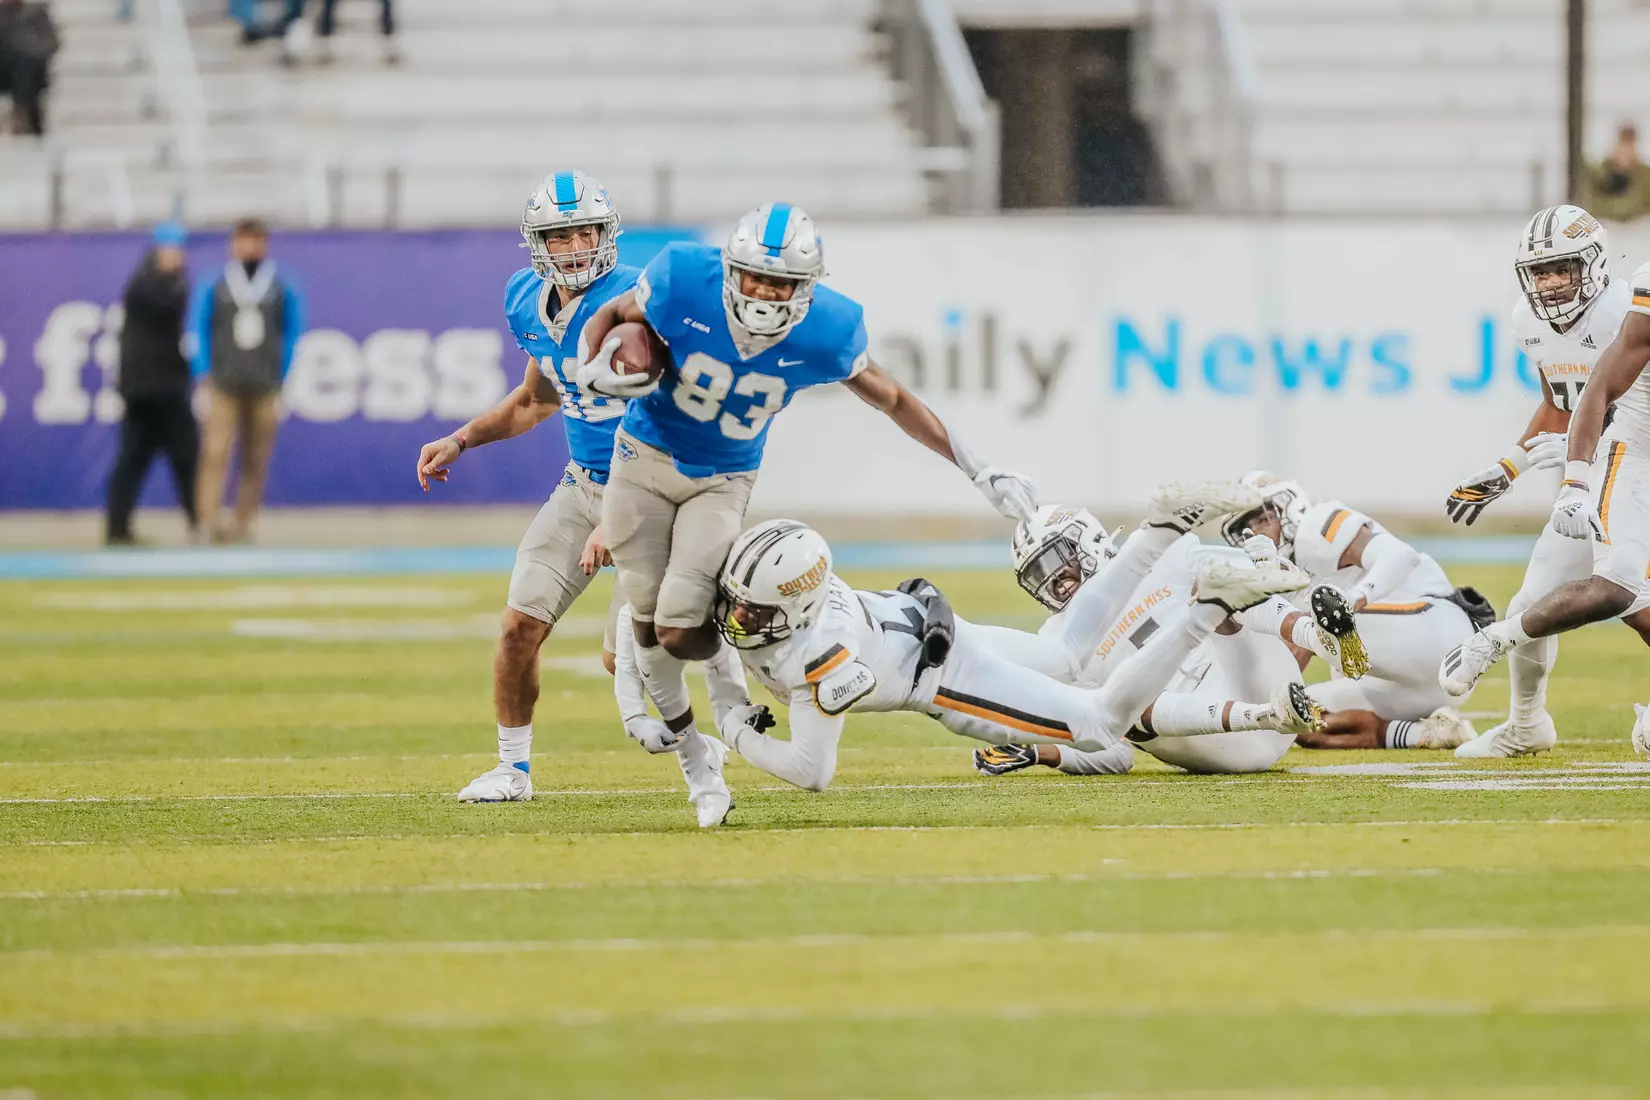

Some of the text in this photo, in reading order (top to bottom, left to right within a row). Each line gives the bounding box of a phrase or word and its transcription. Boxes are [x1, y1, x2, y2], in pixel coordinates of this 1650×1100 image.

[33, 301, 508, 425] fiess
[691, 321, 711, 334] USA
[880, 306, 1075, 420] aily
[1112, 314, 1412, 396] News
[1530, 337, 1541, 345] USA
[672, 351, 788, 440] 83
[1543, 363, 1579, 377] OUTHERN
[1095, 604, 1146, 660] SOUTHERN
[1143, 585, 1173, 609] MISS
